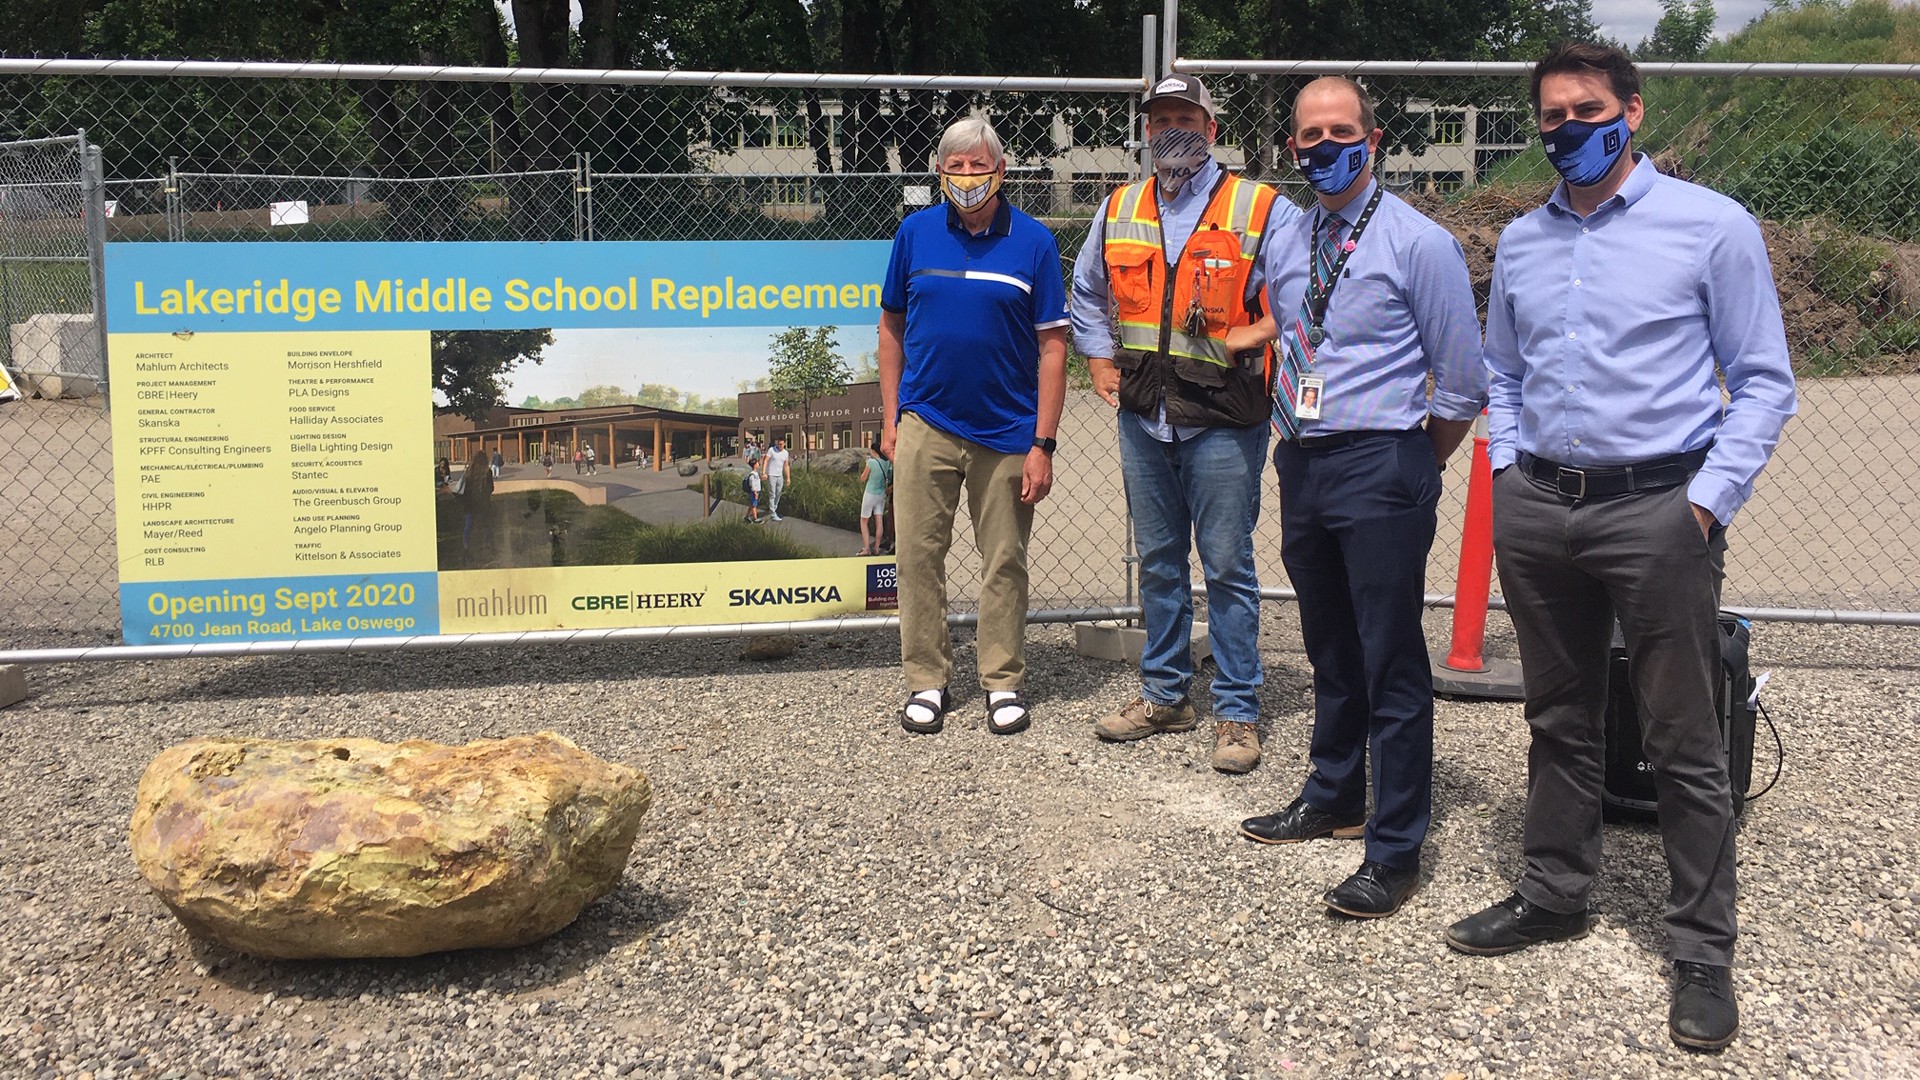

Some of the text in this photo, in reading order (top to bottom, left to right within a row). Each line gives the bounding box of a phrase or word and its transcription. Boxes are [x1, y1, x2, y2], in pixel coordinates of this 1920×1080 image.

[134, 277, 882, 322] Lakeridge Middle School Replacemen
[136, 362, 229, 371] Mahlum Architects
[288, 360, 382, 369] Morrison Hershfield
[289, 388, 350, 398] PLA Designs
[750, 406, 883, 422] LAKERIDGE JUNIOR HIG
[138, 418, 180, 428] Skanska
[290, 415, 383, 426] Halliday Associates
[140, 445, 272, 456] KPFF Consulting Engineers
[291, 442, 393, 453] Biella Lighting Design
[140, 463, 264, 471] MECHANICAL/ELECTRICAL/PLUMBING
[141, 474, 160, 483] PAE
[292, 471, 328, 480] Stantec
[142, 502, 172, 511] HHPR
[293, 496, 401, 506] The Greenbusch Group
[144, 529, 203, 540] Mayer/Reed
[294, 523, 402, 535] Angelo Planning Group
[296, 550, 401, 561] Kittelson & Associates
[145, 557, 164, 566] RLB
[876, 568, 896, 578] LOS
[148, 583, 415, 620] Opening Sept 2020
[729, 586, 842, 607] SKANSKA
[457, 588, 548, 618] mahlum
[150, 615, 415, 638] 4700 Jean Road, Lake Oswego
